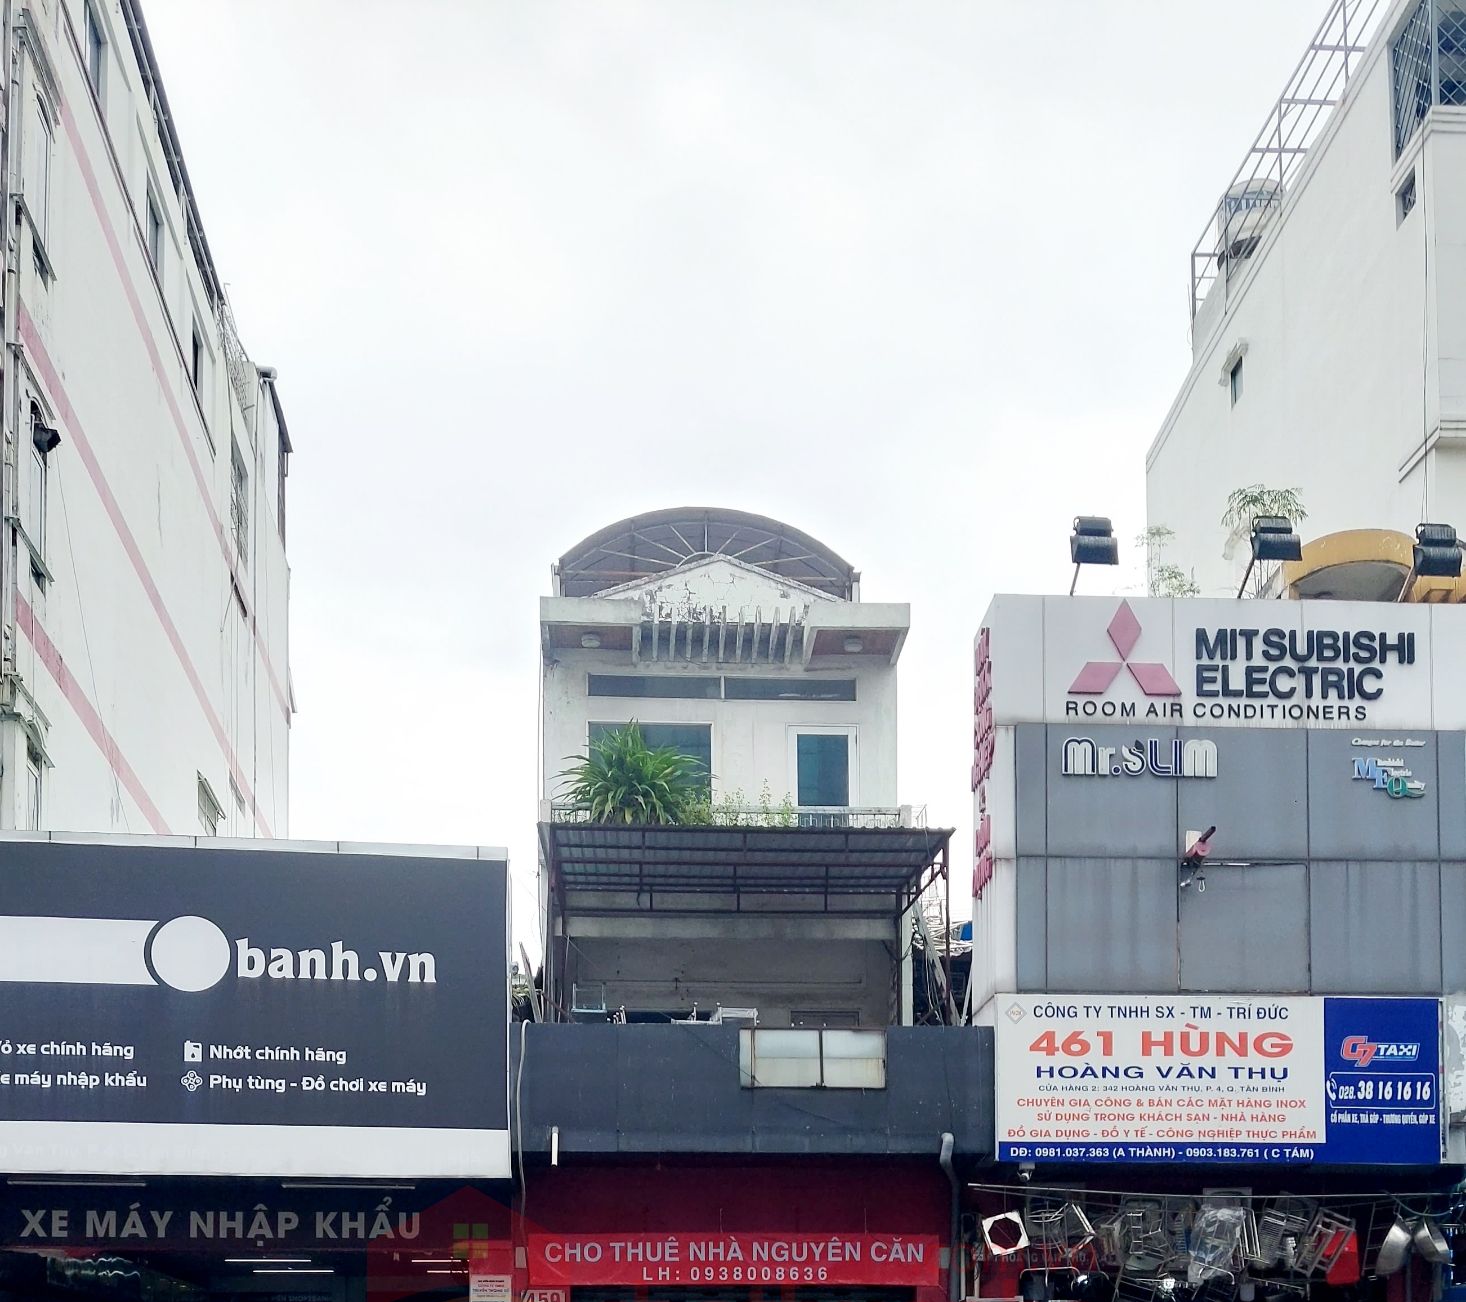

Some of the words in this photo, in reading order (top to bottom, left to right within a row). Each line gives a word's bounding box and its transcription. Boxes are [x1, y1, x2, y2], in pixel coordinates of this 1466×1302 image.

[1195, 627, 1415, 665] MITSUBISHI
[1195, 664, 1384, 701] ELECTRIC
[1065, 701, 1136, 718] ROOM
[1145, 702, 1183, 719] AIR
[1192, 703, 1368, 721] CONDITIONERS
[235, 937, 437, 984] banh.vn
[1033, 1002, 1078, 1018] CÔNG
[1083, 1006, 1102, 1018] TY
[1108, 1006, 1150, 1018] TNHH
[1155, 1006, 1175, 1018] SX
[1190, 1006, 1212, 1019] TM
[1226, 1004, 1252, 1019] TRÍ
[1256, 1003, 1289, 1020] ĐỨC
[1029, 1030, 1113, 1057] 461
[1141, 1023, 1294, 1058] HÙNG
[1377, 1044, 1418, 1056] TAXI
[16, 1043, 37, 1055] xe
[40, 1041, 87, 1056] chính
[91, 1042, 134, 1060] hãng
[209, 1045, 251, 1060] Nhớt
[255, 1046, 300, 1061] chính
[305, 1047, 347, 1064] hãng
[0, 1071, 10, 1085] e
[15, 1071, 52, 1088] máy
[56, 1072, 100, 1089] nhập
[104, 1071, 147, 1087] khẩu
[1036, 1062, 1144, 1079] HOÀNG
[1155, 1062, 1216, 1079] VĂN
[1227, 1066, 1289, 1083] THỤ
[209, 1075, 242, 1092] Phụ
[247, 1076, 286, 1093] tùng
[301, 1076, 326, 1091] Đồ
[330, 1077, 364, 1092] chơi
[368, 1081, 387, 1093] xe
[391, 1079, 427, 1096] máy
[1061, 1084, 1089, 1092] HÀNG
[1121, 1084, 1155, 1092] HOÀNG
[1261, 1085, 1285, 1093] BÌNH
[1339, 1086, 1356, 1099] 028.
[1357, 1081, 1374, 1100] 38
[1378, 1081, 1393, 1100] 16
[1397, 1081, 1412, 1100] 16
[1416, 1081, 1431, 1100] 16
[1017, 1097, 1065, 1107] CHUYÊN
[1069, 1098, 1091, 1107] GIA
[1095, 1097, 1132, 1107] CÔNG
[1136, 1099, 1144, 1107] &
[1148, 1097, 1172, 1107] BÁN
[1176, 1097, 1205, 1108] CÁC
[1208, 1097, 1233, 1110] MẶT
[1236, 1097, 1272, 1109] HÀNG
[1276, 1100, 1306, 1109] INOX
[1037, 1110, 1052, 1122] SỬ
[1055, 1113, 1090, 1124] DỤNG
[1094, 1113, 1135, 1121] TRONG
[1139, 1111, 1183, 1122] KHÁCH
[1186, 1113, 1210, 1124] SẠN
[1221, 1111, 1247, 1122] NHÀ
[1250, 1111, 1287, 1123] HÀNG
[1030, 1129, 1052, 1138] GIA
[1055, 1129, 1090, 1140] DỤNG
[1123, 1129, 1131, 1138] Y
[1134, 1125, 1148, 1138] TẾ
[1156, 1127, 1193, 1138] CÔNG
[1198, 1128, 1242, 1140] NGHIỆP
[1246, 1129, 1278, 1141] THỰC
[1282, 1126, 1317, 1139] PHẨM
[1010, 1147, 1032, 1157] DĐ:
[1035, 1147, 1109, 1158] 0981.037.363
[1113, 1147, 1126, 1159] (A
[1129, 1145, 1175, 1158] THÀNH)
[1186, 1148, 1260, 1158] 0903.183.761
[1284, 1146, 1314, 1159] TÁM)
[20, 1210, 68, 1238] XE
[85, 1202, 173, 1239] MÁY
[189, 1204, 300, 1247] NHẬP
[315, 1196, 421, 1241] KHẨU
[544, 1243, 603, 1263] CHO
[609, 1237, 681, 1263] THUÊ
[689, 1235, 742, 1263] NHÀ
[752, 1237, 862, 1263] NGUYÊN
[870, 1237, 924, 1264] CĂN
[642, 1267, 682, 1281] LH:
[691, 1267, 828, 1281] 0938008636
